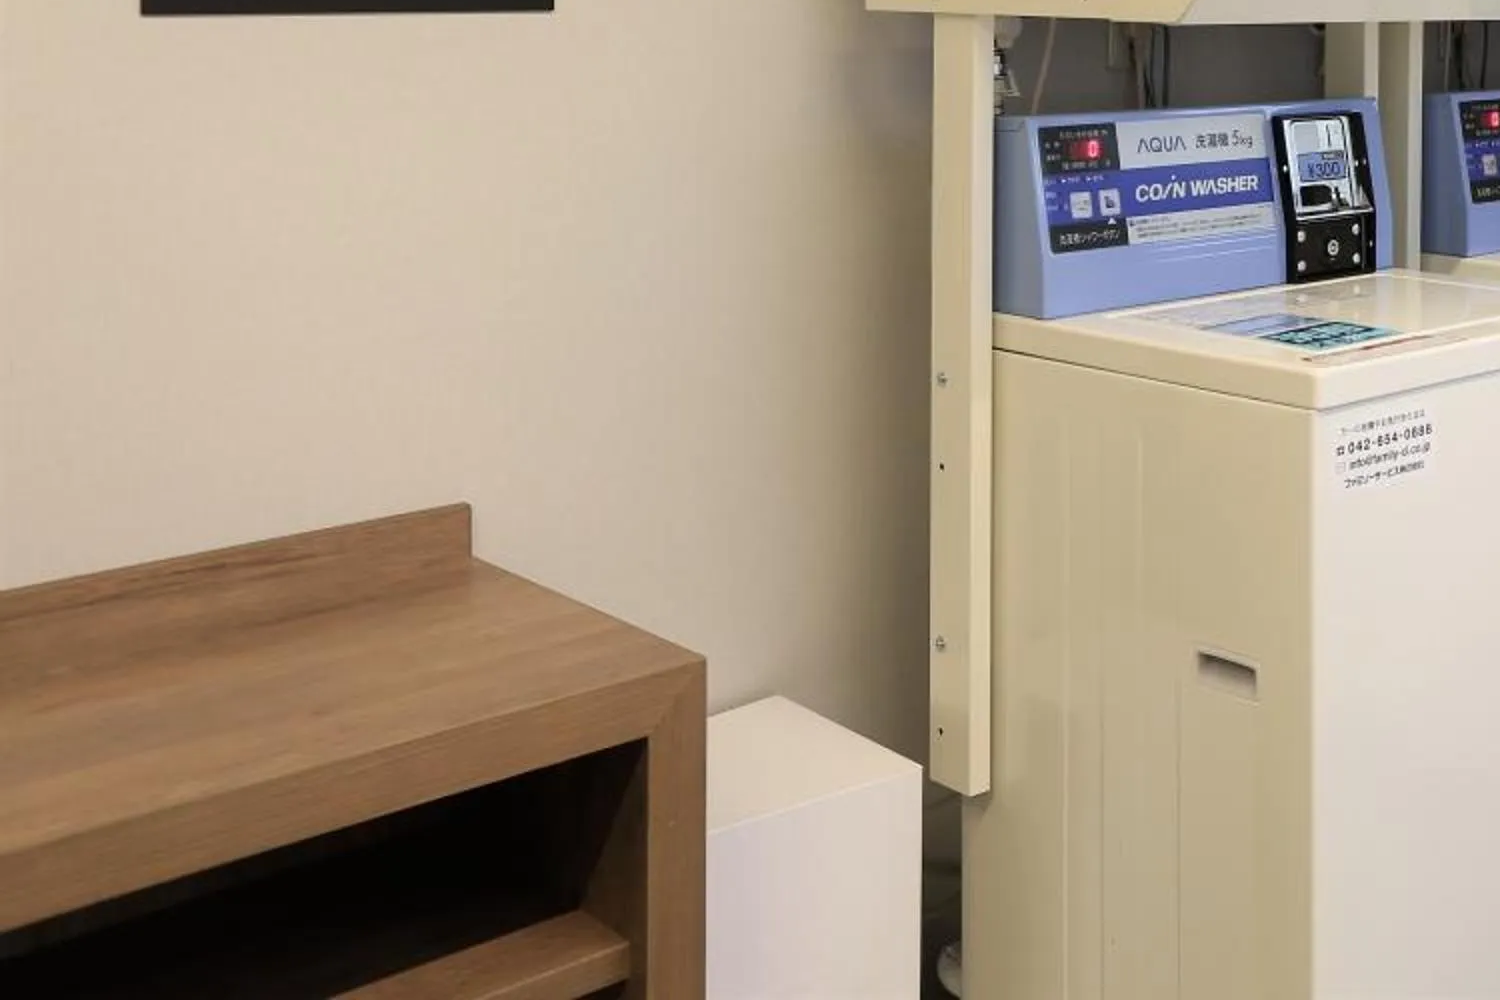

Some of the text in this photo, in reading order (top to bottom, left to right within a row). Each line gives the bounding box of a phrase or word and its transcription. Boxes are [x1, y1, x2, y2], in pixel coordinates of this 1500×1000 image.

[1087, 140, 1100, 158] 0
[1137, 135, 1187, 153] AQUA
[1189, 175, 1259, 197] WASHER
